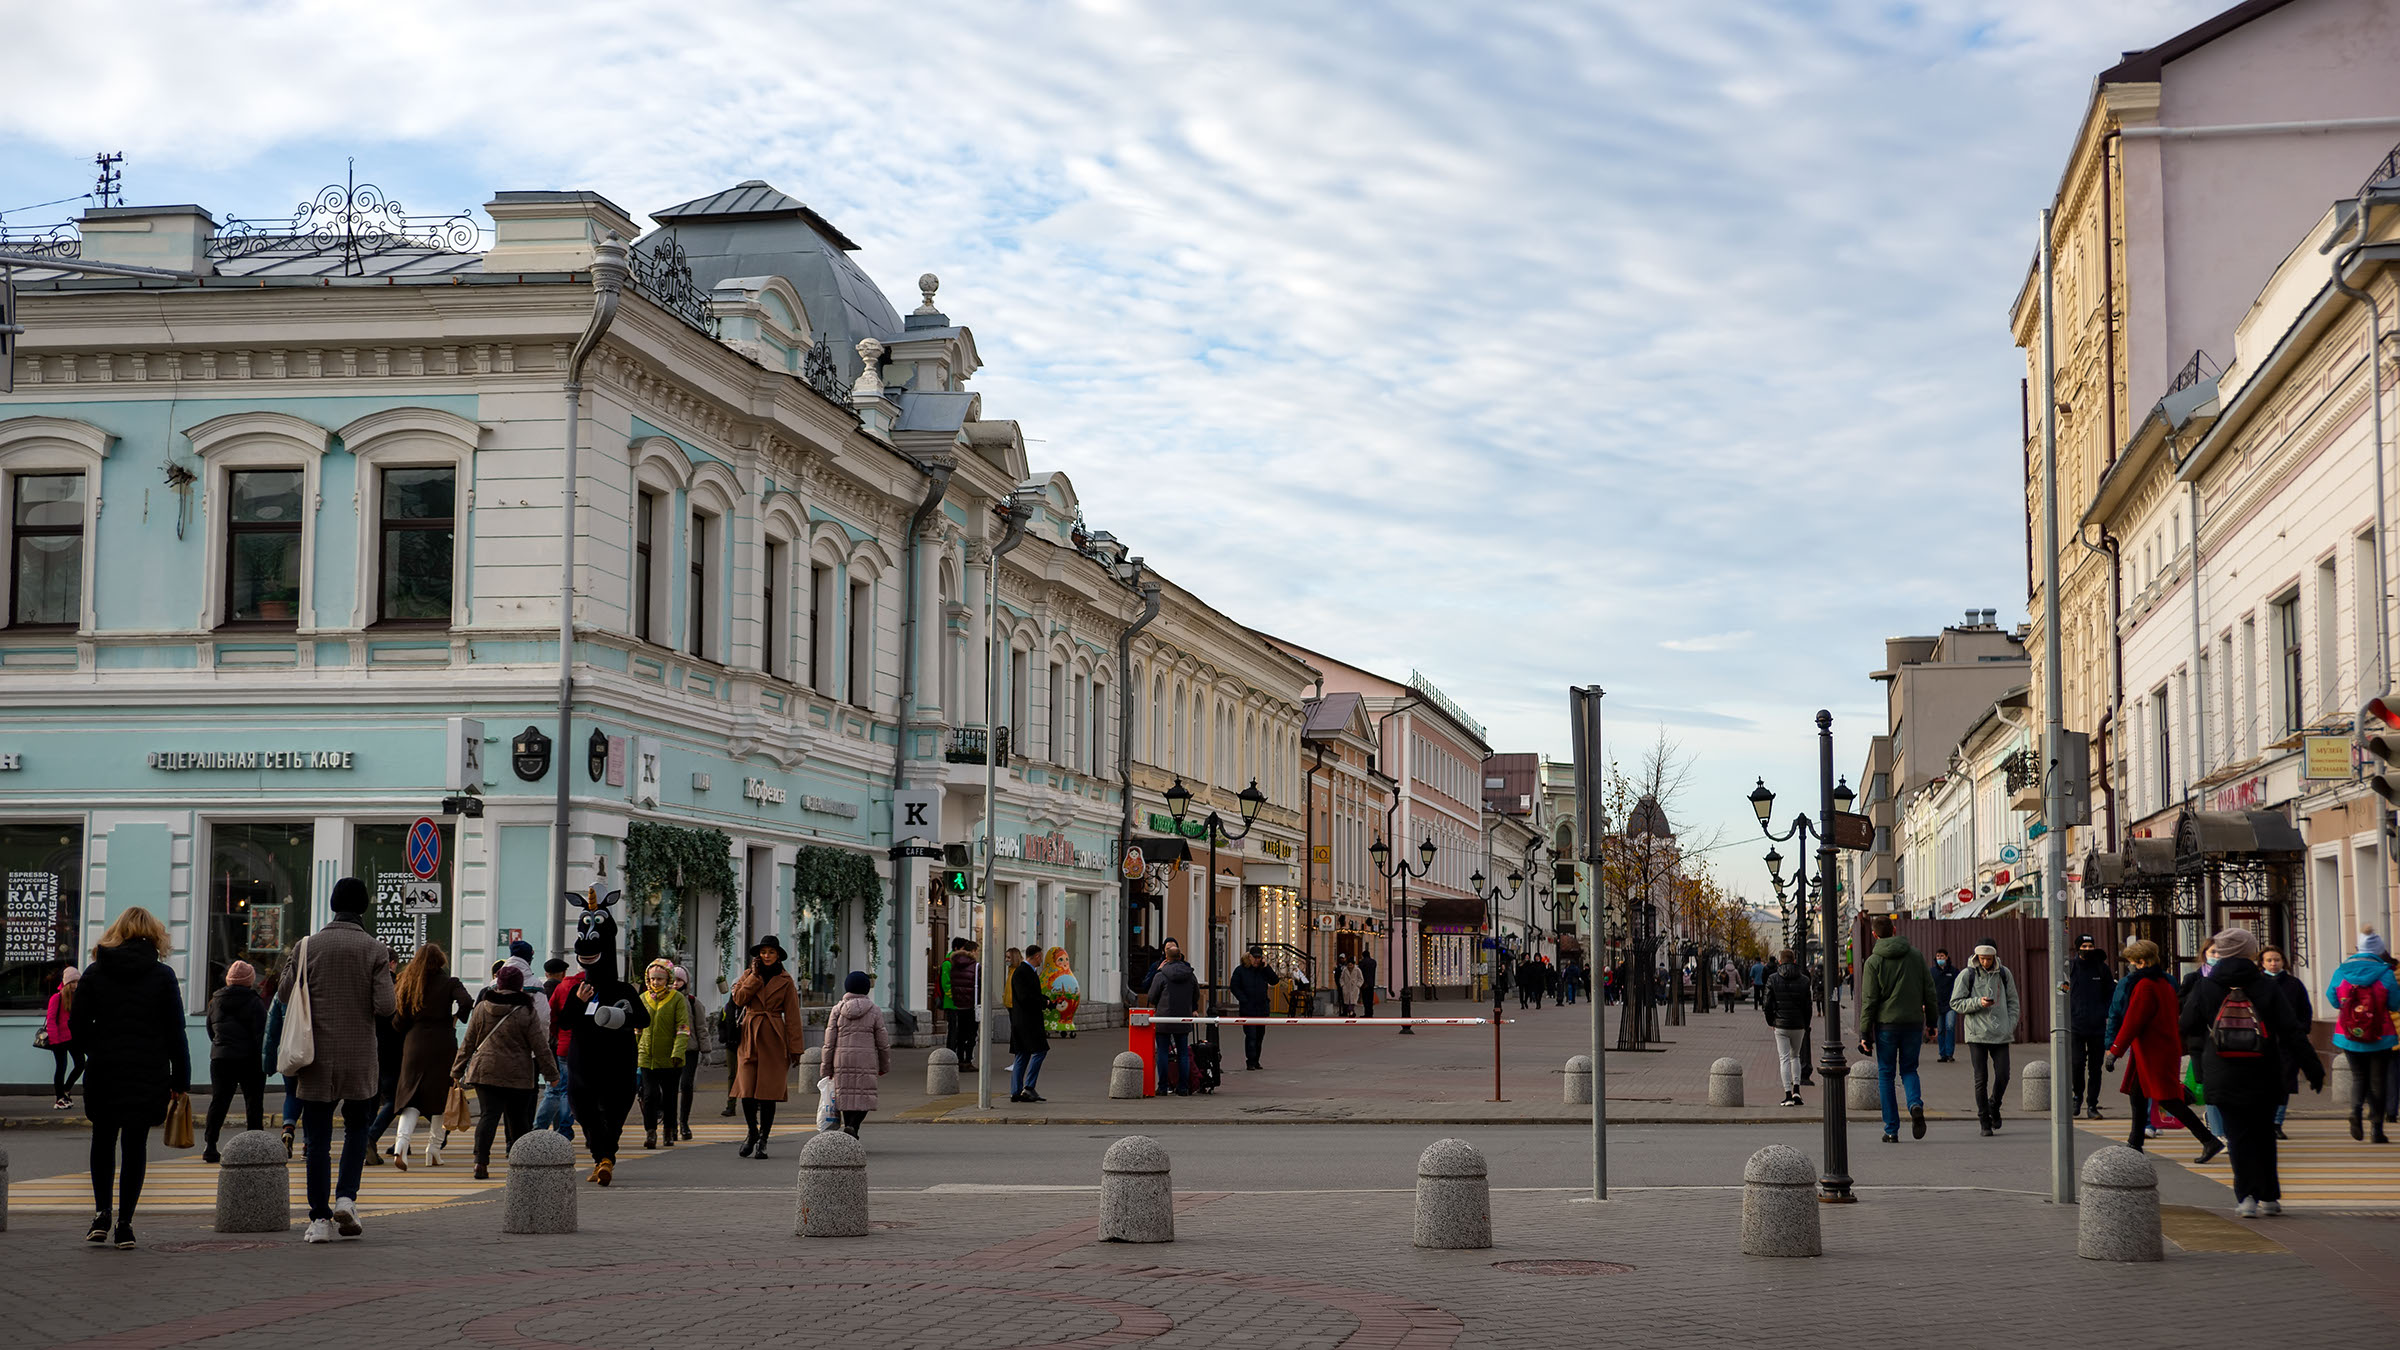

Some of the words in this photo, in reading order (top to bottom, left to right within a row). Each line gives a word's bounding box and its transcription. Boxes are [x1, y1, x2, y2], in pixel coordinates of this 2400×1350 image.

[2316, 746, 2343, 754] МУЗЕЙ
[147, 751, 256, 770] ФЕДЕРАЛЬНАЯ
[264, 751, 302, 769] СЕТЬ
[311, 751, 352, 769] КАФЕ
[747, 777, 787, 807] Кофеин
[905, 847, 924, 856] CAFE
[8, 883, 48, 891] LATTE
[376, 884, 403, 892] ЛАТ
[8, 891, 48, 902] RAF
[48, 872, 59, 928] TAKEAWAY
[376, 892, 403, 904] РА
[7, 902, 47, 910] COCOA
[5, 934, 46, 942] SOUPS
[47, 929, 57, 944] DO
[46, 946, 55, 962] WE
